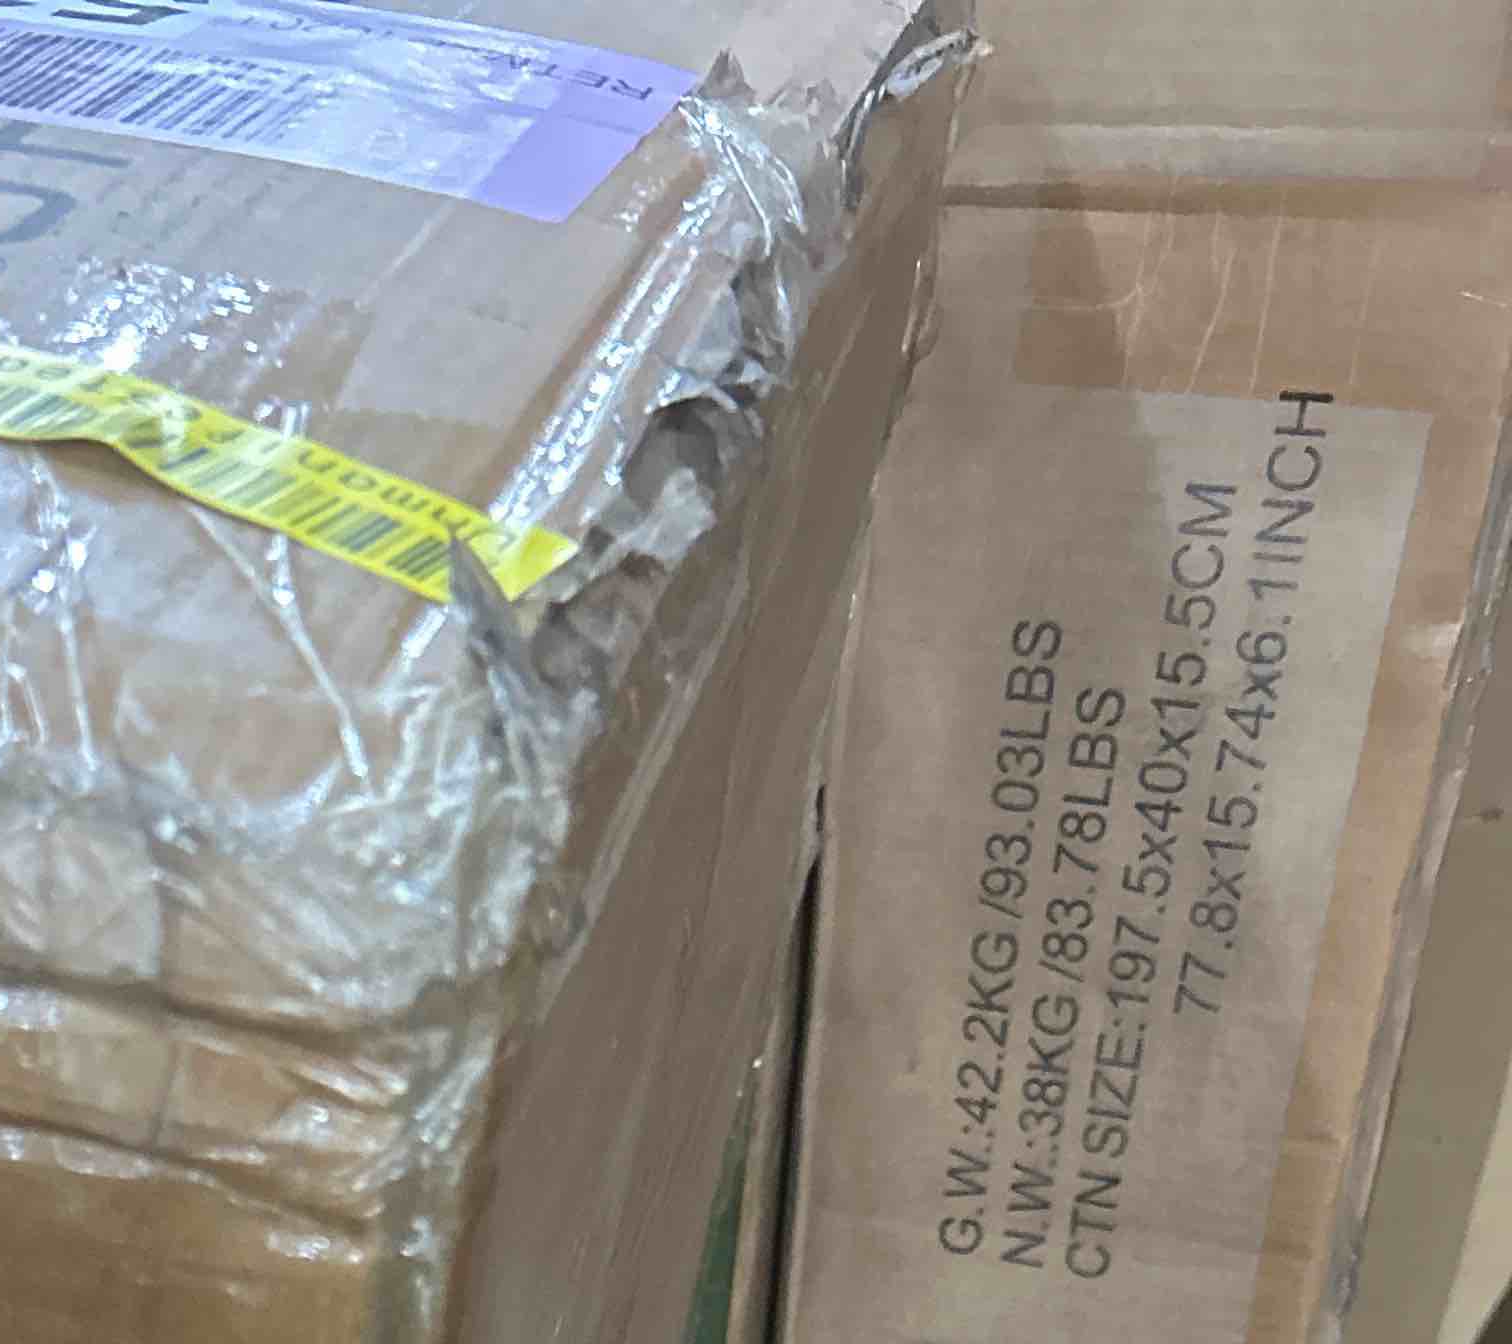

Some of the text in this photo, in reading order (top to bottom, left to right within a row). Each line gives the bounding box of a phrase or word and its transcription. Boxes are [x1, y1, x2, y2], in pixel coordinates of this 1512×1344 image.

[939, 618, 1064, 1258] G.W.:42.2KG /93.03LBS
[1001, 687, 1127, 1270] N.W.:38KG /83.78LBS
[1065, 1167, 1123, 1280] CTN
